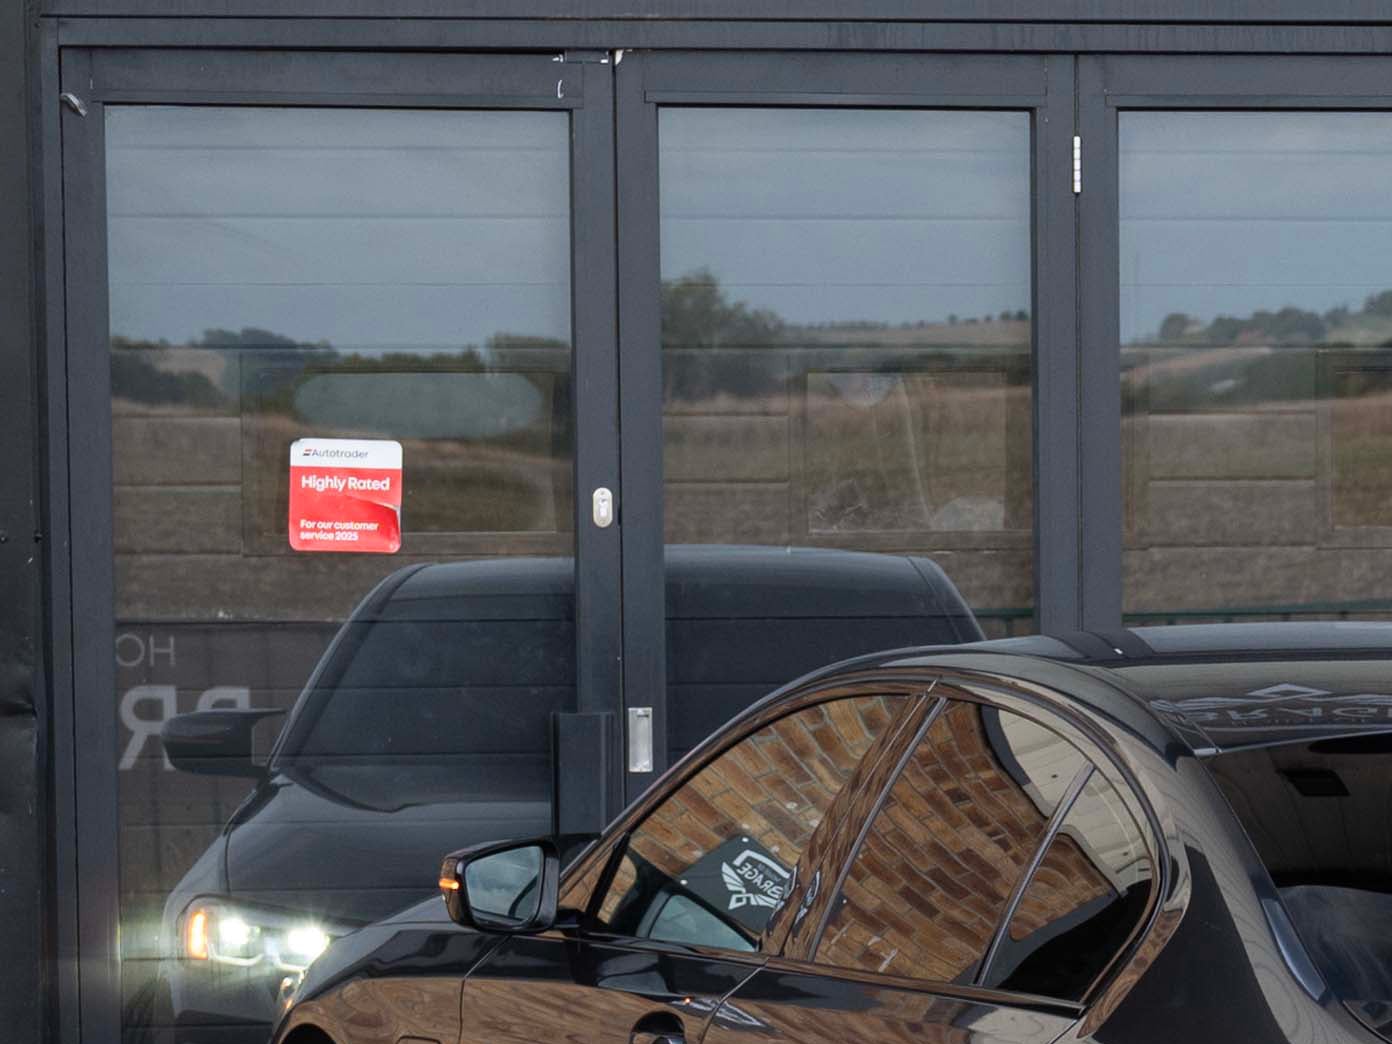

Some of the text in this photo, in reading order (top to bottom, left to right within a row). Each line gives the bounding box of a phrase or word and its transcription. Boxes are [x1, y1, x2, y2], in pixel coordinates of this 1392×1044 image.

[312, 448, 368, 458] Autotrader
[301, 475, 390, 492] Highly Rated
[300, 519, 379, 530] For our customer
[300, 530, 334, 540] service
